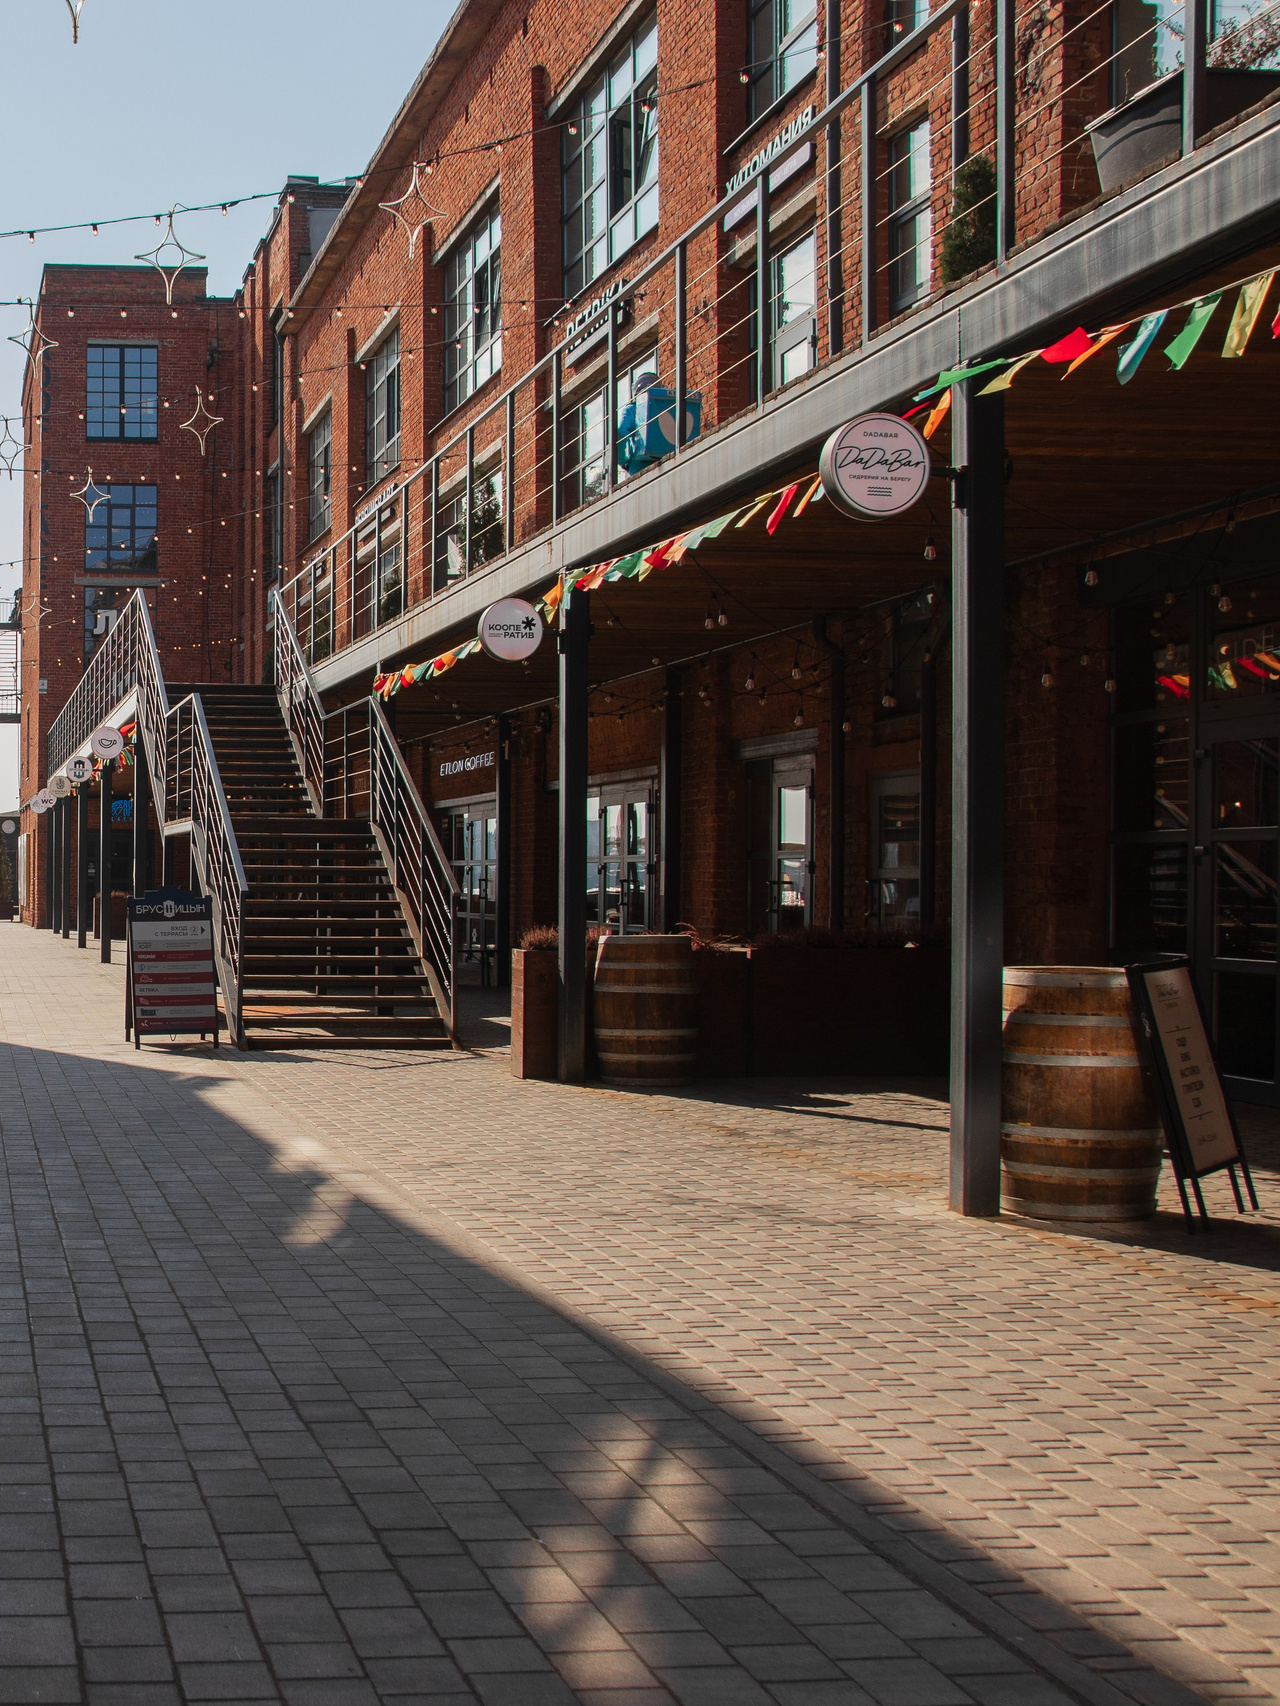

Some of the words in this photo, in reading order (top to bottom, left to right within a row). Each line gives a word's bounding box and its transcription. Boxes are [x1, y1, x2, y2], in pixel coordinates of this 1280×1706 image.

[725, 105, 816, 196] ХИТОМАНИЯ
[863, 431, 899, 439] DADABAR
[837, 446, 925, 472] DaDaBar
[488, 623, 522, 632] КООПЕ
[503, 631, 535, 639] РАТИВ
[439, 759, 464, 777] ETLON
[464, 751, 496, 771] COFFEE
